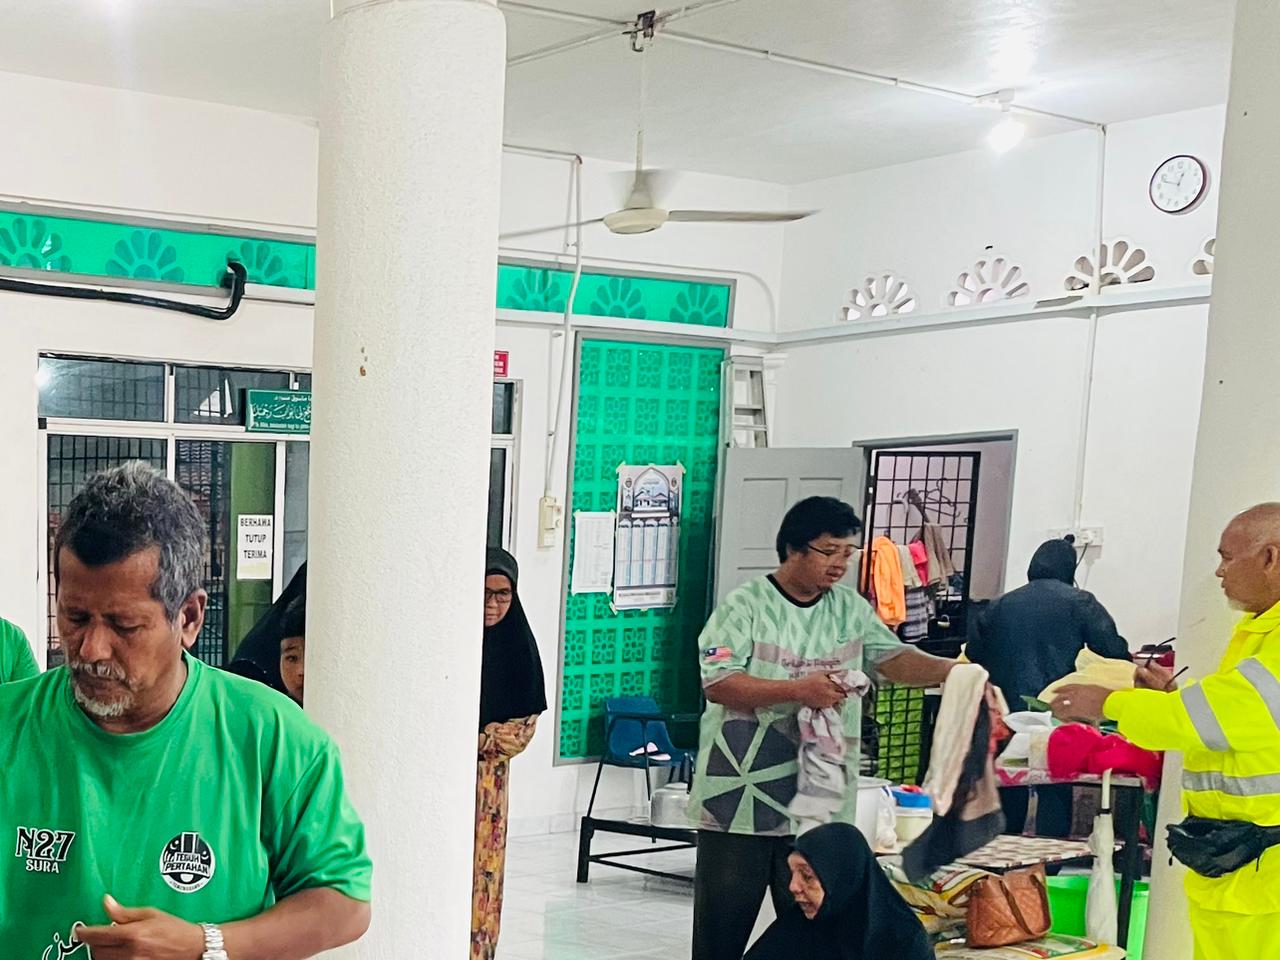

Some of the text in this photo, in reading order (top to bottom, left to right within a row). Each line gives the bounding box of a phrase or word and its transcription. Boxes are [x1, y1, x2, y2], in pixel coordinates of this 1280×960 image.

[245, 534, 267, 543] TUTUP
[243, 550, 267, 559] TERIMA
[14, 826, 76, 862] N27
[175, 853, 200, 863] TEGUH
[25, 859, 60, 873] SURA
[164, 862, 209, 875] PERTAHAN
